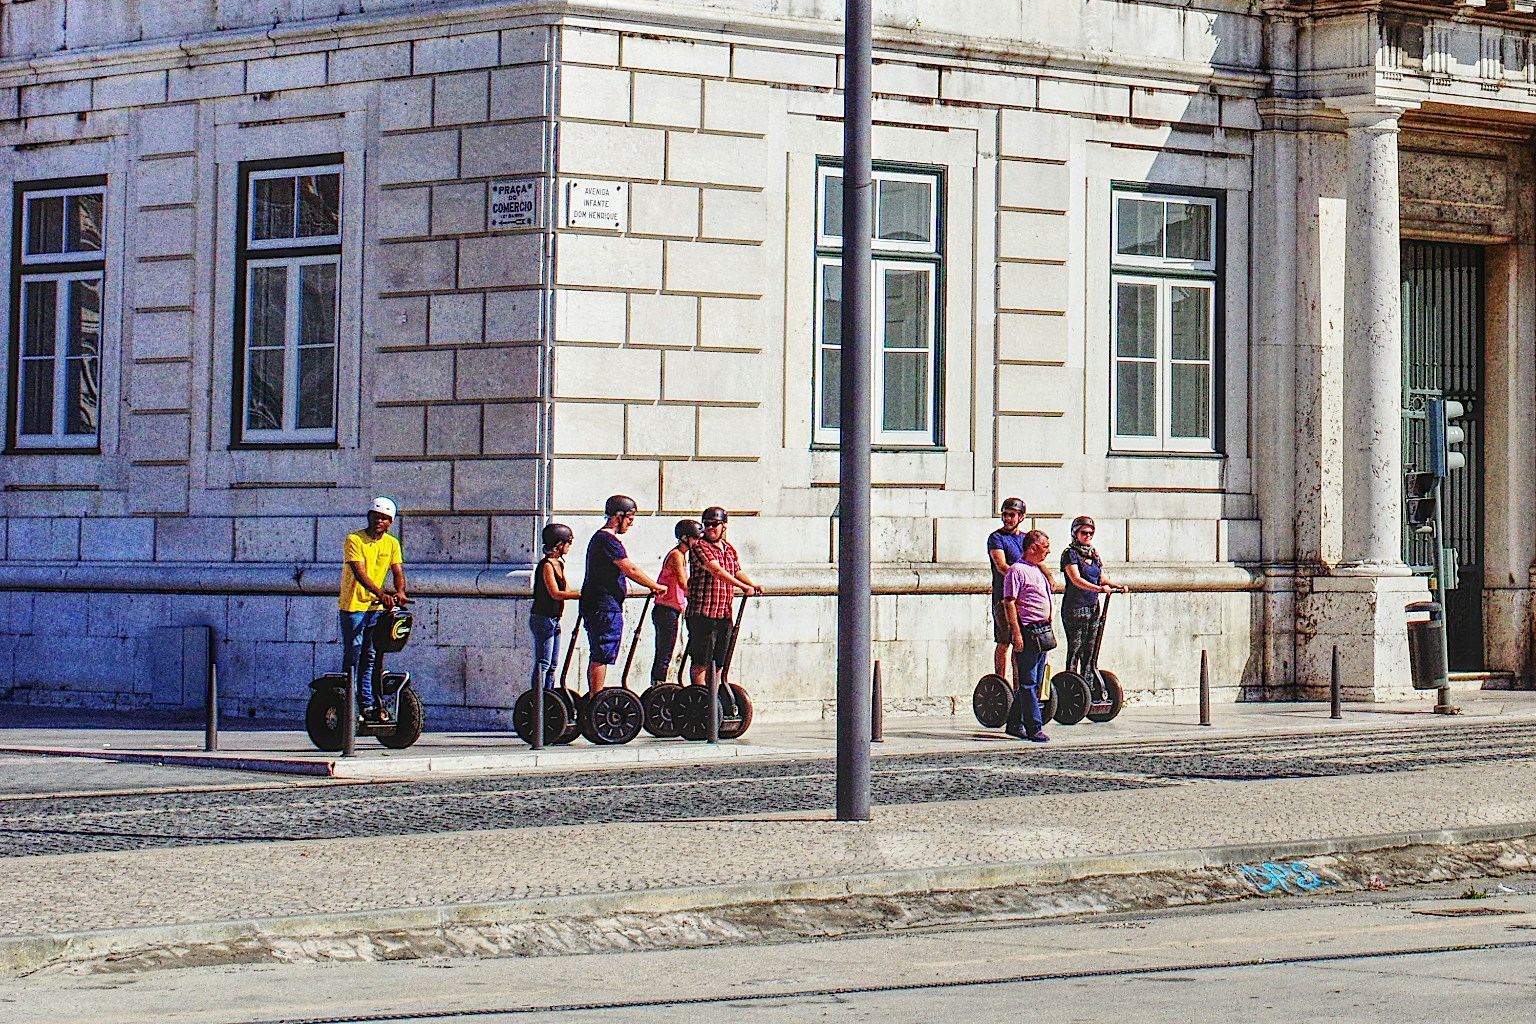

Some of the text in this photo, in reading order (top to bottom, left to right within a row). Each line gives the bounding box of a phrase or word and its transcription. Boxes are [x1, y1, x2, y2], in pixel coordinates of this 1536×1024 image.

[498, 184, 528, 196] PRAÇA
[584, 187, 610, 196] AVENIDA
[492, 200, 533, 213] COMERCIO
[583, 199, 610, 208] INFANTE
[573, 210, 619, 221] DOM HENRIQUE
